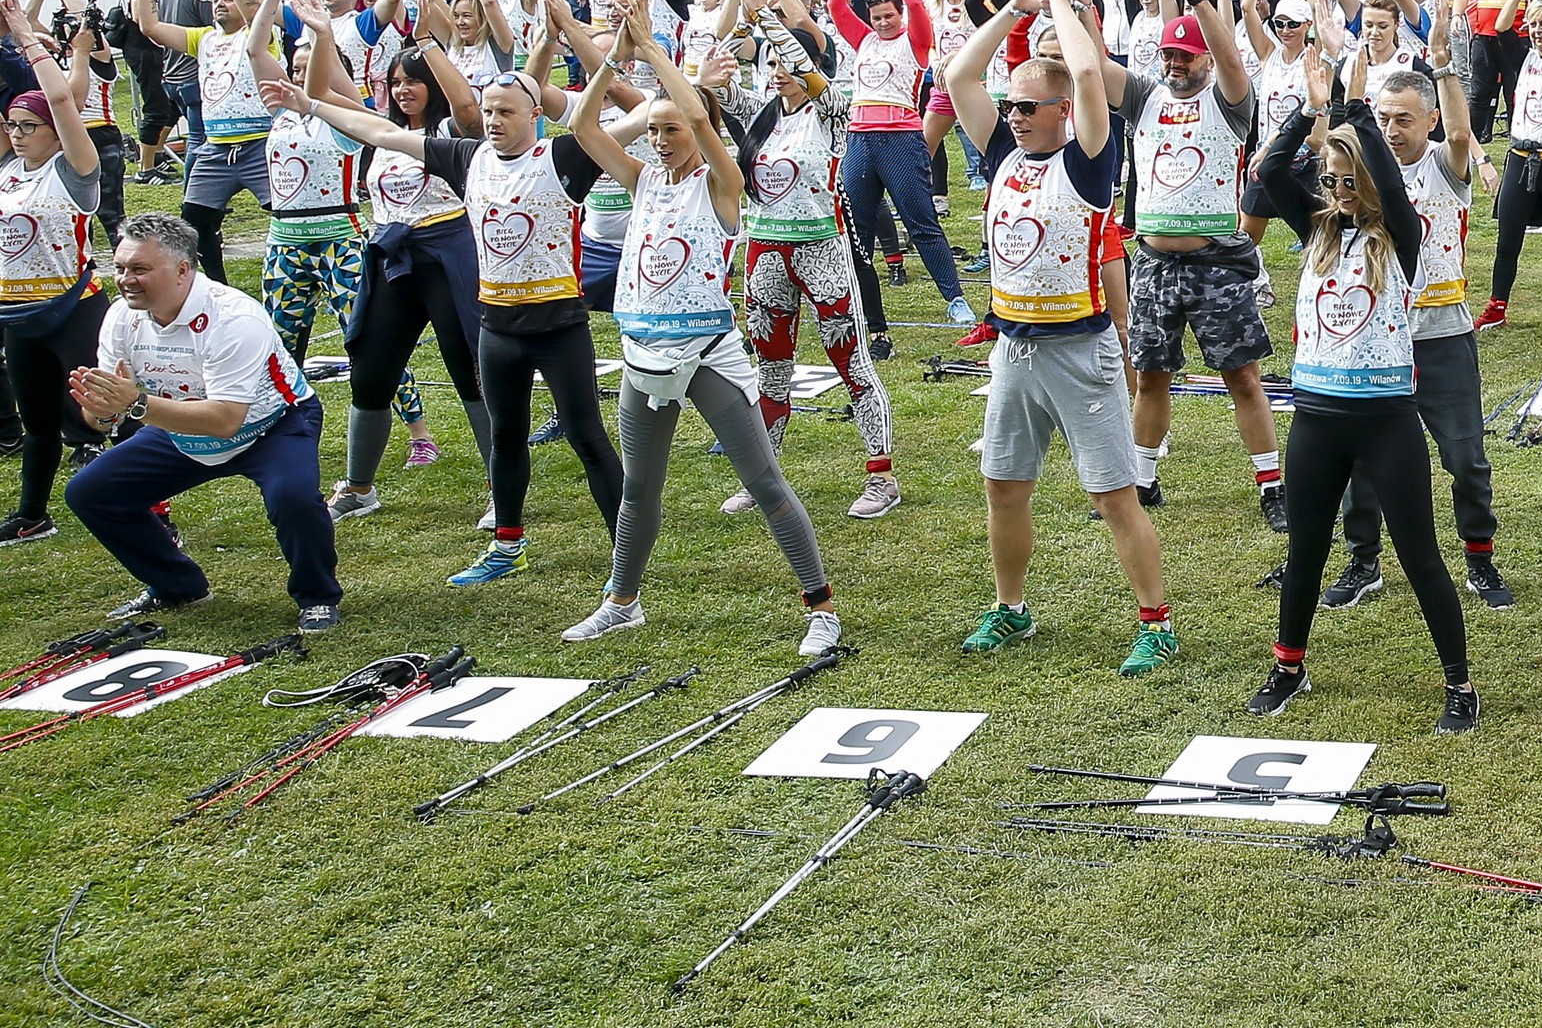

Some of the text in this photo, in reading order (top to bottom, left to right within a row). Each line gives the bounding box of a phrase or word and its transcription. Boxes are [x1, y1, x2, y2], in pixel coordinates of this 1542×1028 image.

[796, 223, 827, 232] Wilanów
[1164, 219, 1191, 228] 7.09.19
[1005, 233, 1023, 241] BIEG
[1010, 241, 1032, 249] NOWE
[8, 284, 34, 292] 7.09.19
[1427, 287, 1459, 298] Wilanów
[1008, 300, 1079, 311] 7.09.19 Wilanów
[1333, 303, 1354, 311] BIEG
[1338, 310, 1366, 318] NOWE
[195, 316, 205, 330] 8
[653, 319, 680, 329] 7.09.19
[686, 317, 722, 328] Wilanów
[1296, 370, 1401, 385] Warszawa 7.09.19 Wilanów
[63, 660, 189, 703] 8
[408, 686, 514, 729] 7
